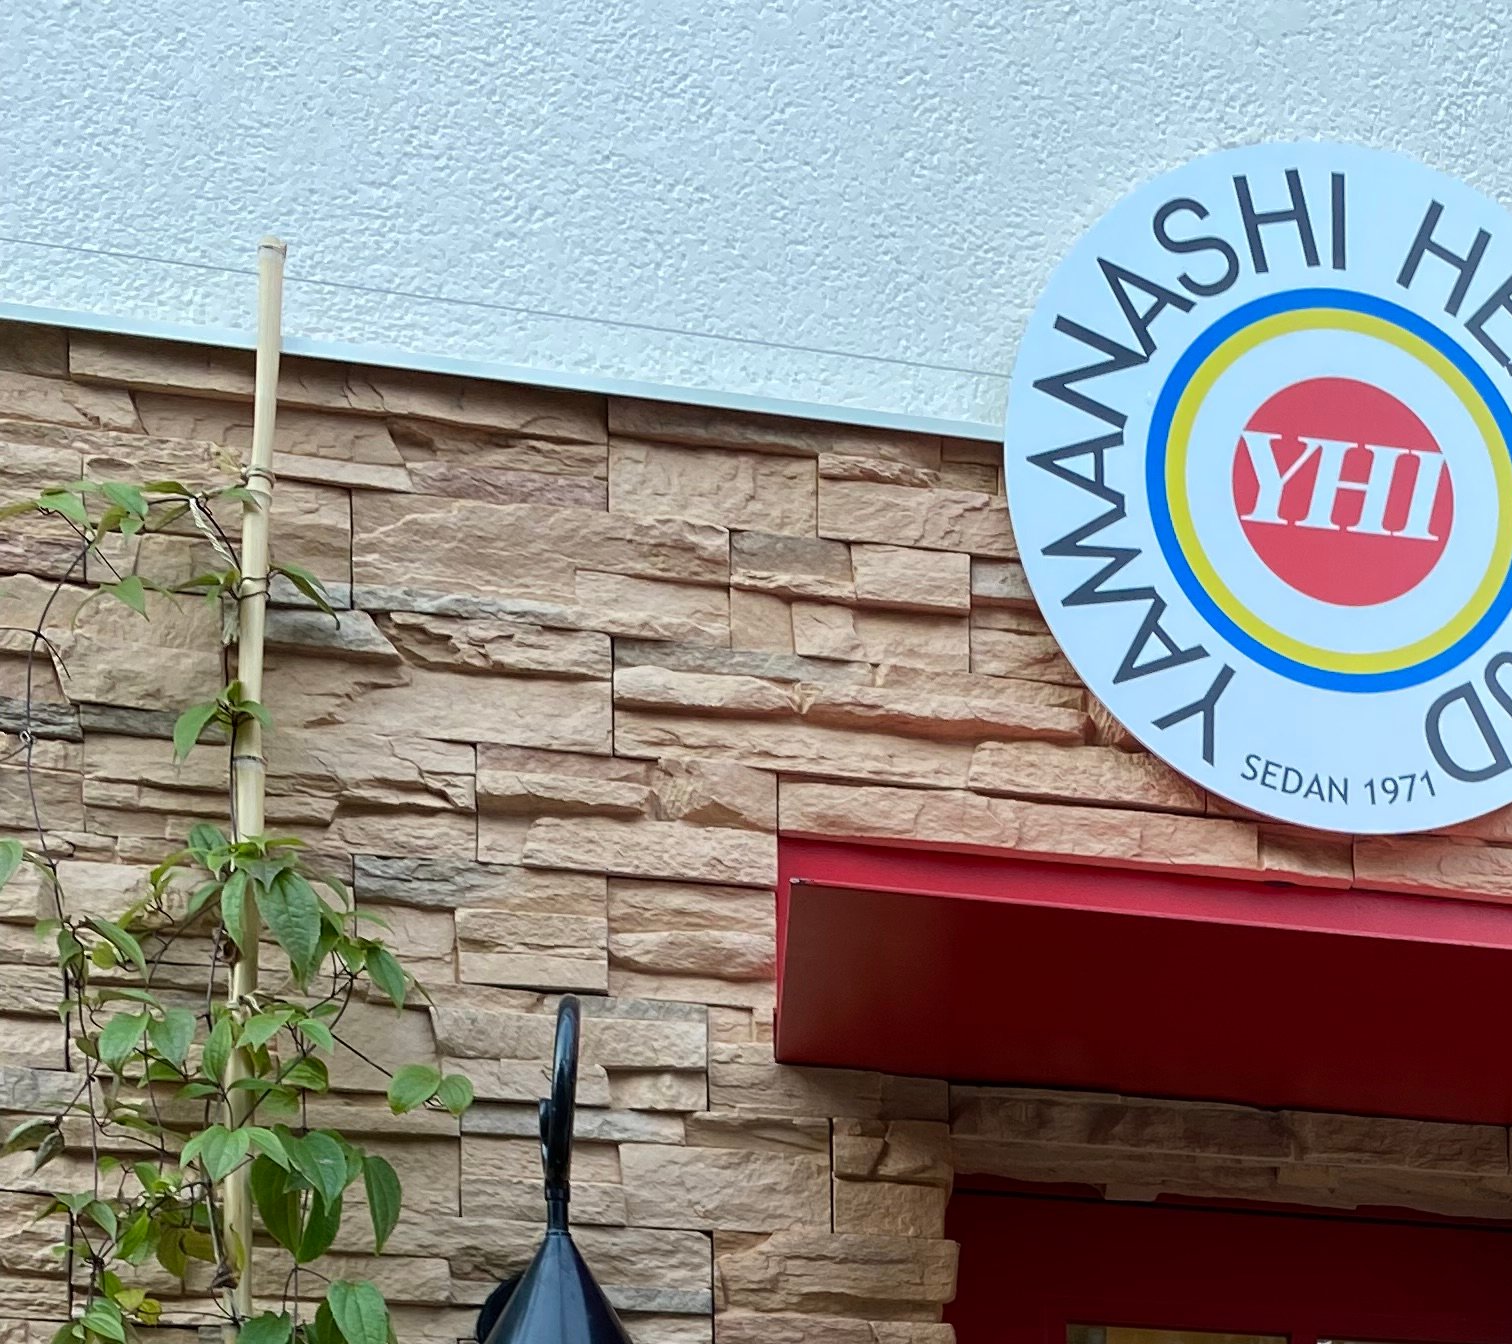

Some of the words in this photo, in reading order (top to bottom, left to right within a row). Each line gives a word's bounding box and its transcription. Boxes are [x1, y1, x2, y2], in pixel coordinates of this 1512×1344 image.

[1025, 167, 1346, 767] YAMANASHI
[1239, 429, 1446, 542] YHI
[1240, 753, 1349, 805] SEDAN
[1363, 769, 1436, 805] 1971
